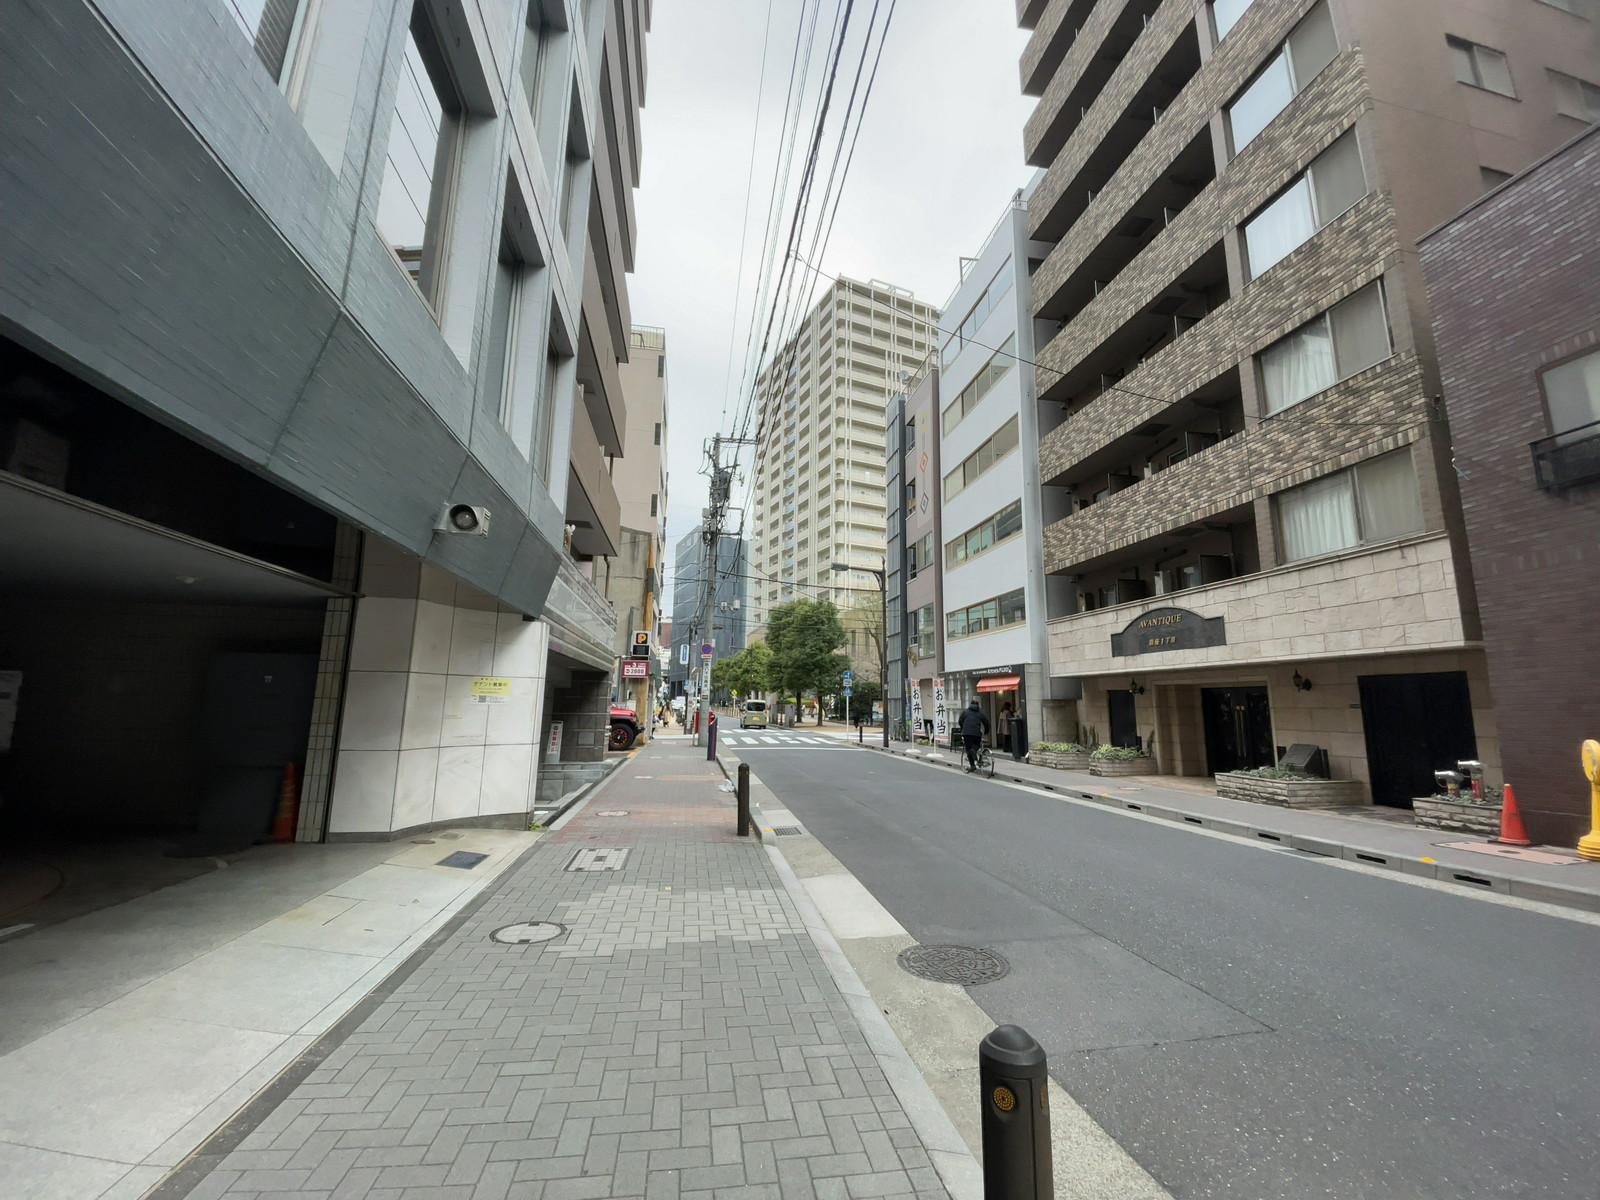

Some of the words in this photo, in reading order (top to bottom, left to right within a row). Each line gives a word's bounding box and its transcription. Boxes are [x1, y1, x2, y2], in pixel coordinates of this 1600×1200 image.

[1138, 614, 1182, 628] AVANTIQUE
[912, 687, 922, 731] お弁当
[935, 687, 947, 735] お弁当
